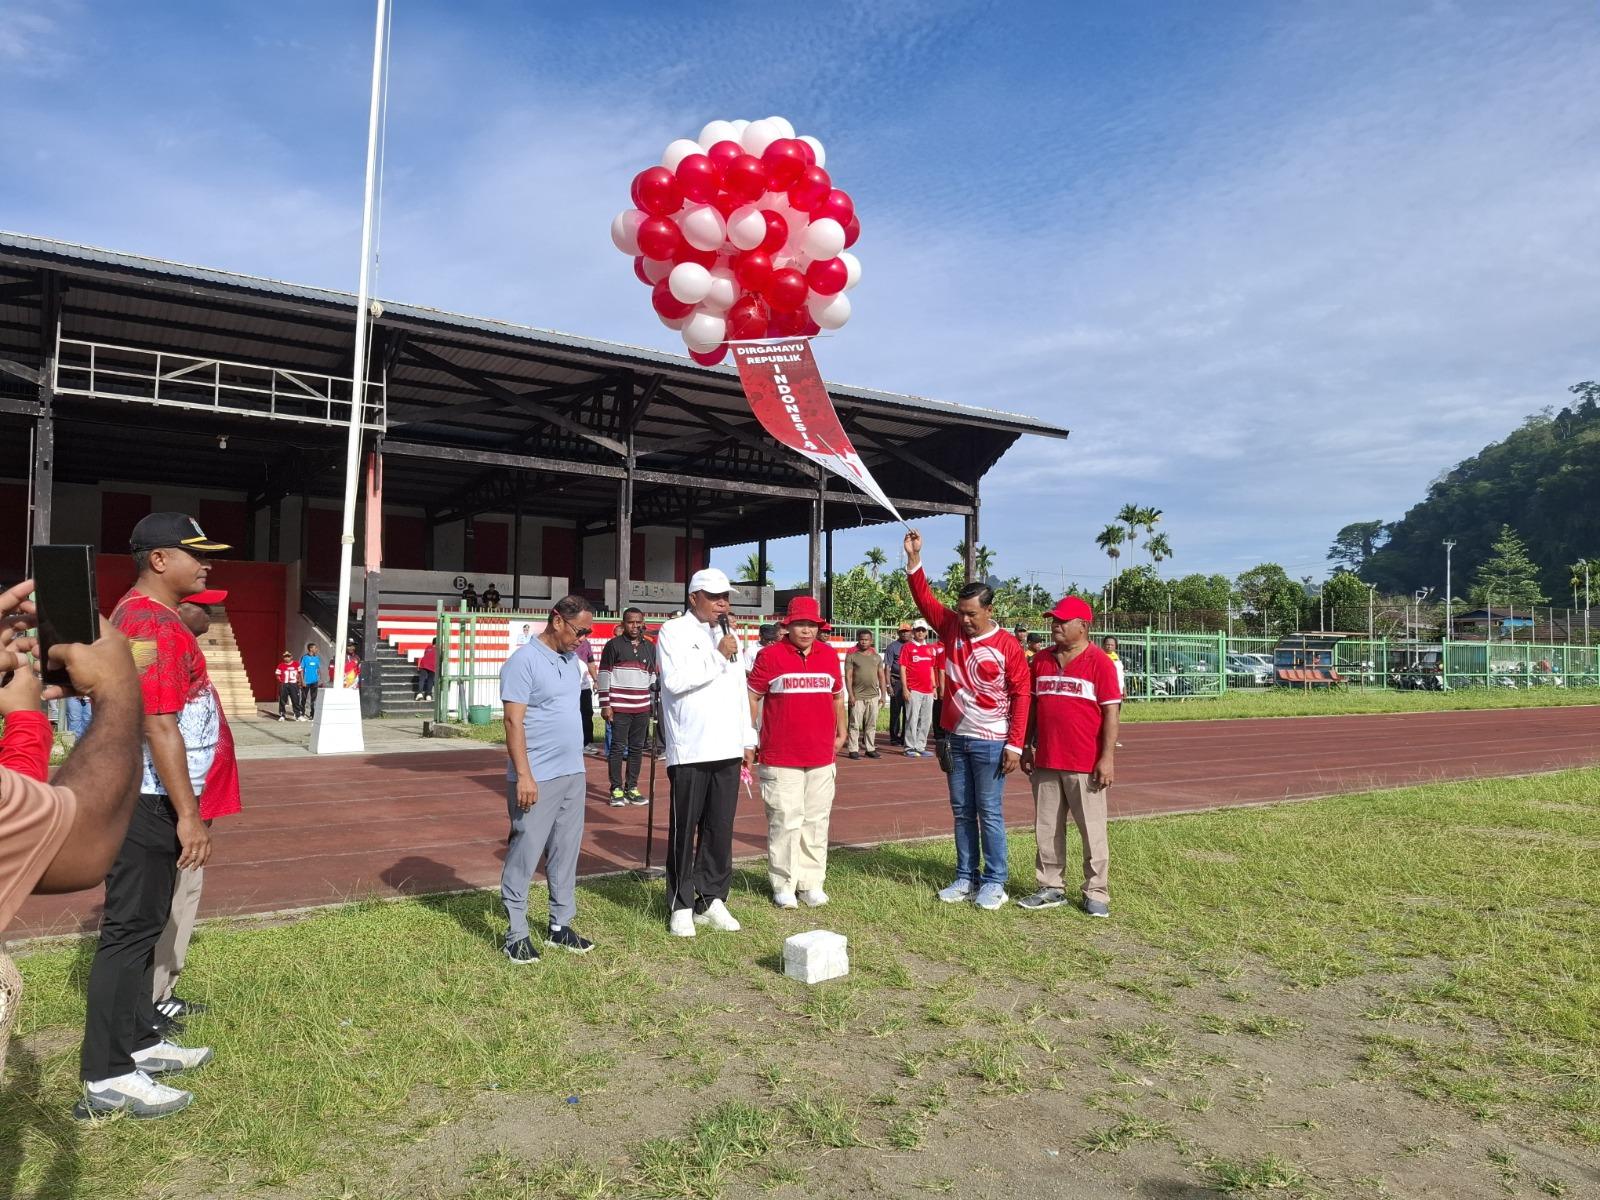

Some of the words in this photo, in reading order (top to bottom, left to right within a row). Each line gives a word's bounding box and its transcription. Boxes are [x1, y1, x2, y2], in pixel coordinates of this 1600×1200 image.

[737, 344, 804, 355] DIRGAHAYU
[747, 355, 801, 364] REPUBLIK
[773, 364, 818, 450] INDONESIA
[284, 670, 297, 683] 19
[783, 677, 830, 688] INDONESIA
